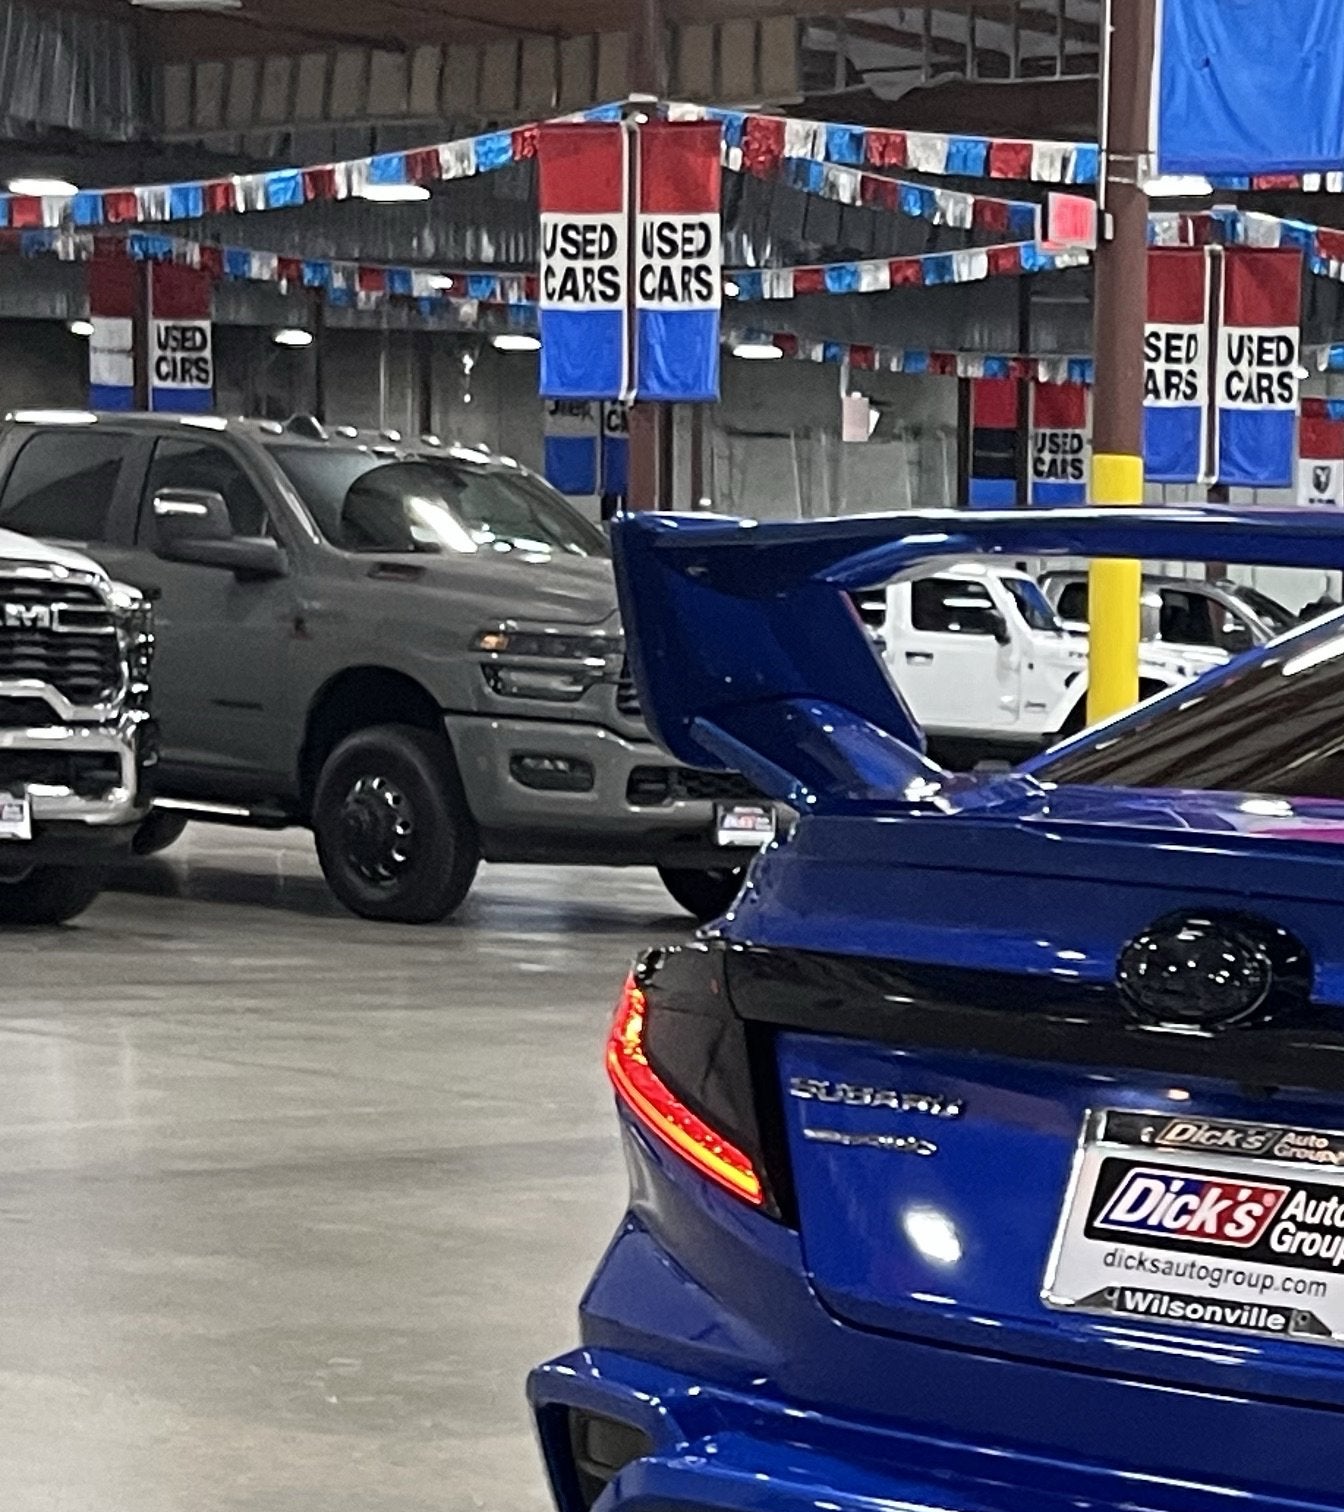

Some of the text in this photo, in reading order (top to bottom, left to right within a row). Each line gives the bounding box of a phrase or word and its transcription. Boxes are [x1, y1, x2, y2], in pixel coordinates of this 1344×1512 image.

[543, 222, 618, 261] USED
[642, 221, 712, 260] USED
[543, 264, 621, 303] CARS
[639, 263, 714, 303] CARS
[157, 323, 208, 353] USED
[1143, 331, 1198, 364] SED
[1227, 333, 1295, 367] USED
[1144, 368, 1198, 401] ARS
[1225, 370, 1294, 404] CARS
[1034, 432, 1084, 455] USED
[1280, 1131, 1330, 1149] Auto
[1108, 1176, 1264, 1239] Dick's
[1103, 1248, 1328, 1298] dicksautogroup.com
[1124, 1289, 1287, 1332] Wilsonville
